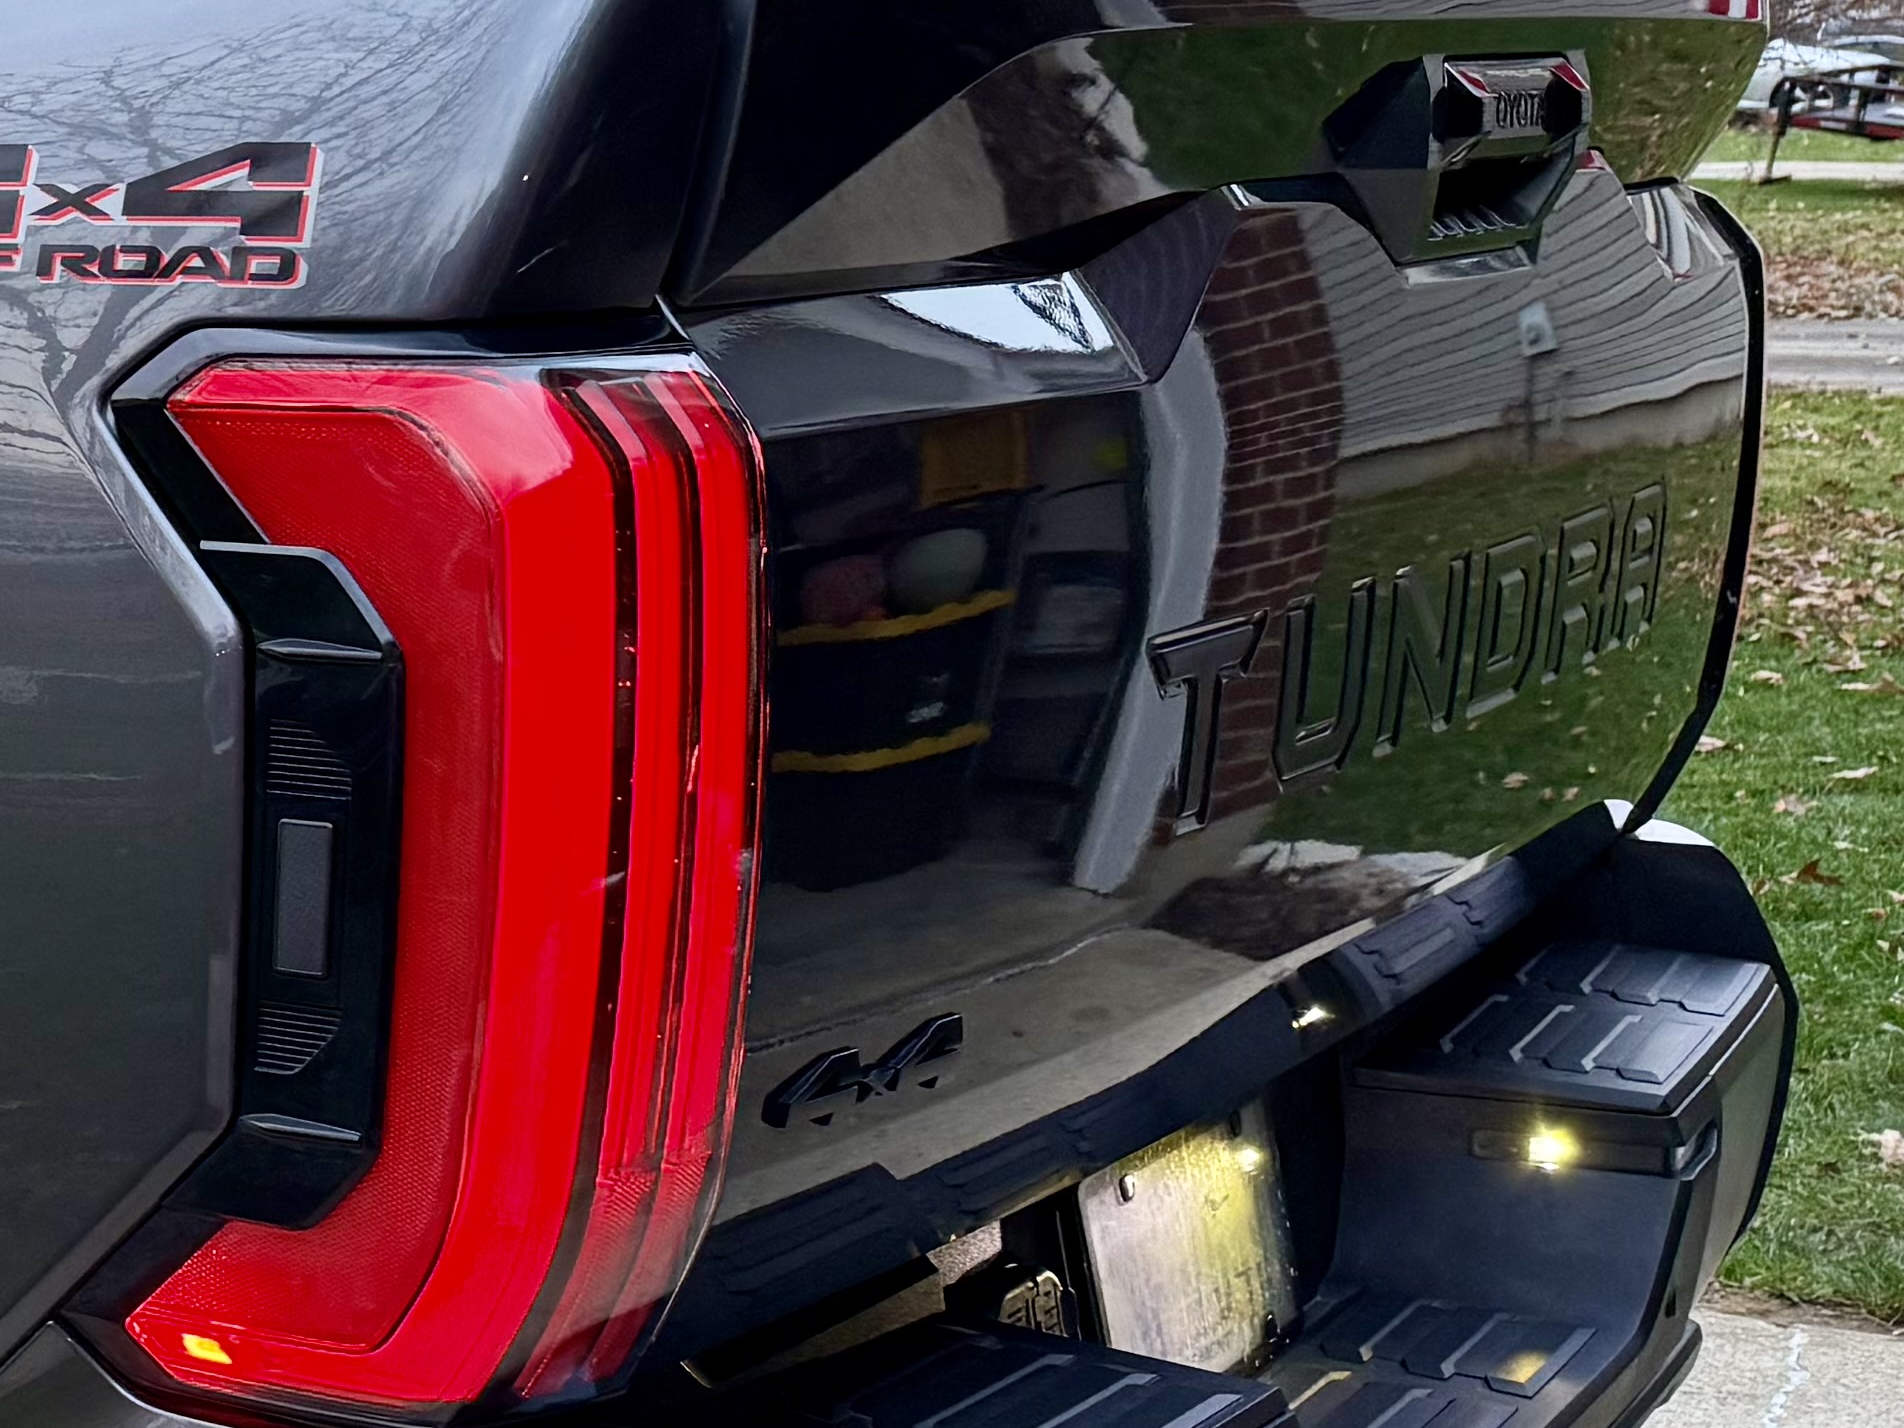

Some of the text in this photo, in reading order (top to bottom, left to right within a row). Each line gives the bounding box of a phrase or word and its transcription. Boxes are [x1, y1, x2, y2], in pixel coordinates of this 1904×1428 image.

[1491, 90, 1544, 129] OYOTA
[34, 241, 309, 290] ROAD
[1145, 479, 1669, 837] TUNDRA
[760, 1011, 964, 1129] 4x4
